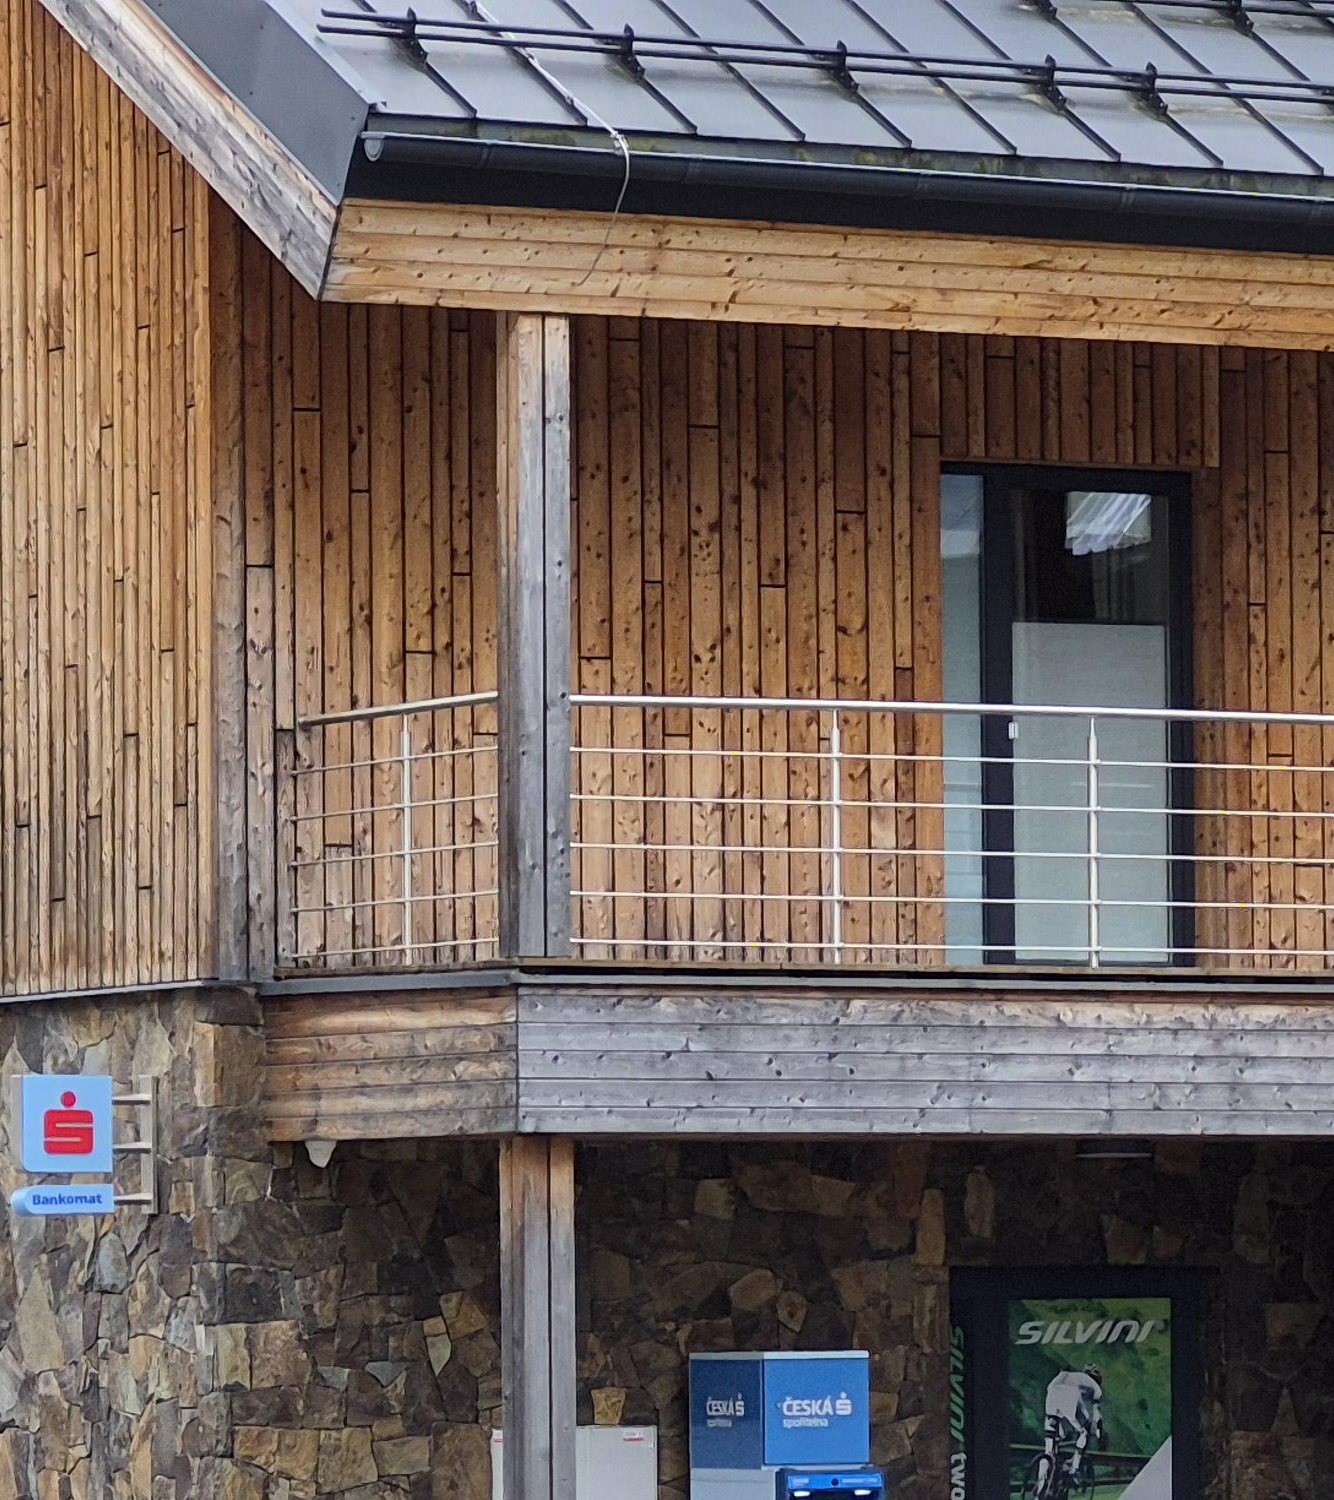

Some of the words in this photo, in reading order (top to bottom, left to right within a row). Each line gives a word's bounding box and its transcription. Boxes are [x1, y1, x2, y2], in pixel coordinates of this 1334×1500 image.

[31, 1192, 103, 1206] Bankomat
[1014, 1320, 1156, 1345] SILVINI
[950, 1325, 965, 1443] SILVINI
[782, 1396, 834, 1416] ČESKÁ
